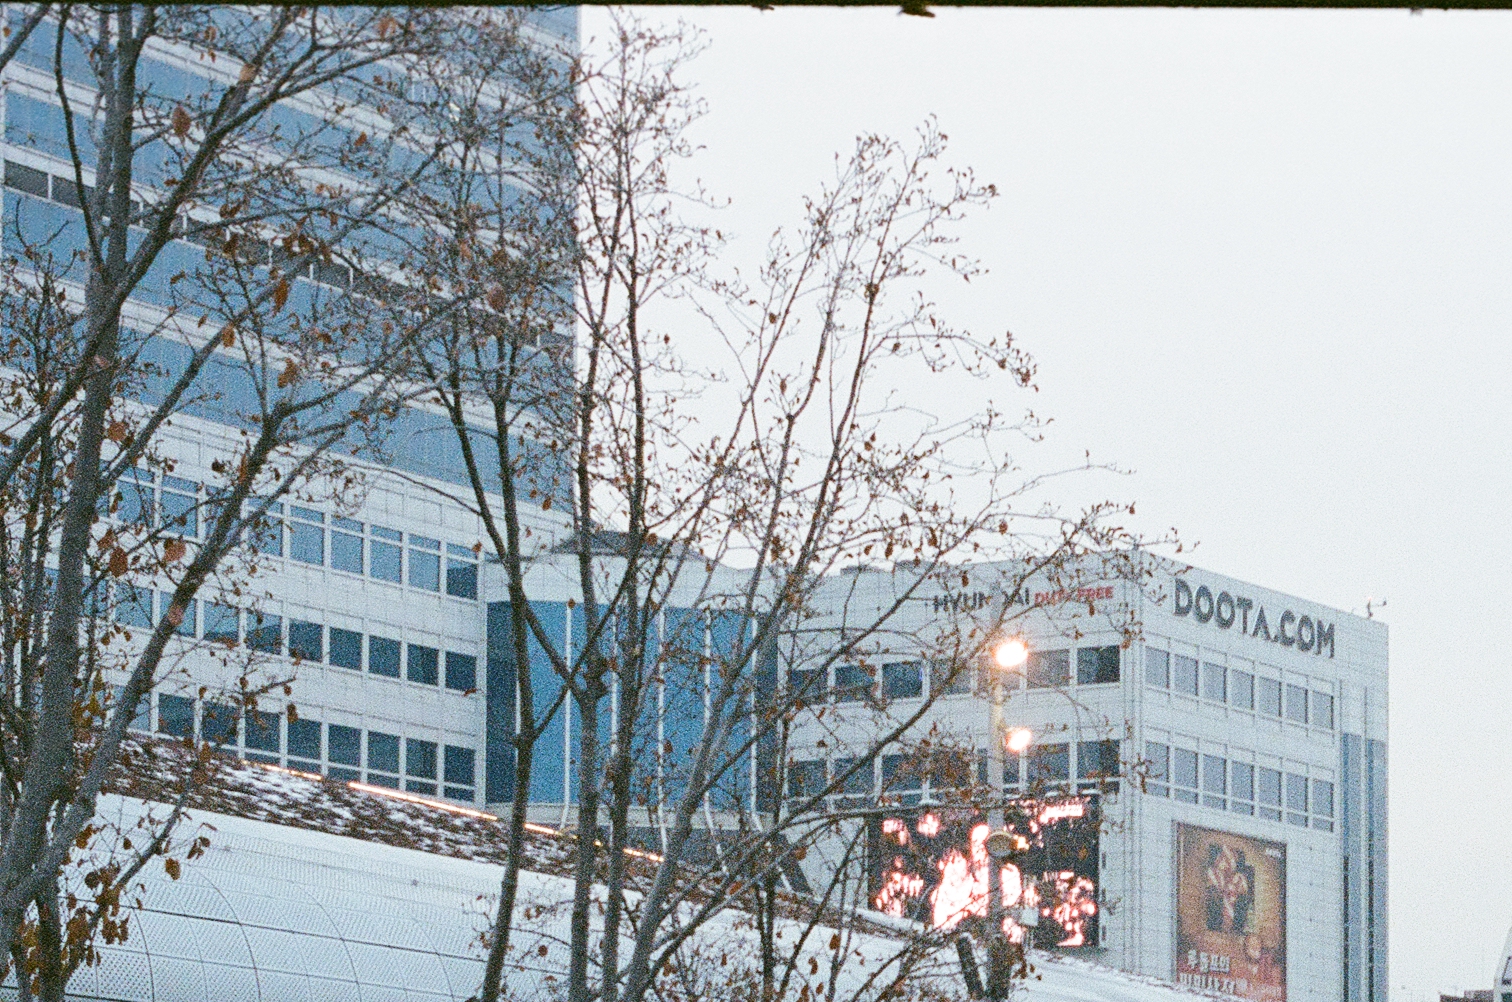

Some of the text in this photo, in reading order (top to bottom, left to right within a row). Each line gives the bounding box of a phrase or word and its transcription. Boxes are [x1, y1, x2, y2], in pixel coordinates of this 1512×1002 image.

[933, 586, 1030, 612] HYUNAI
[1076, 586, 1115, 602] FREE
[1173, 577, 1337, 659] DOOTA.COM
